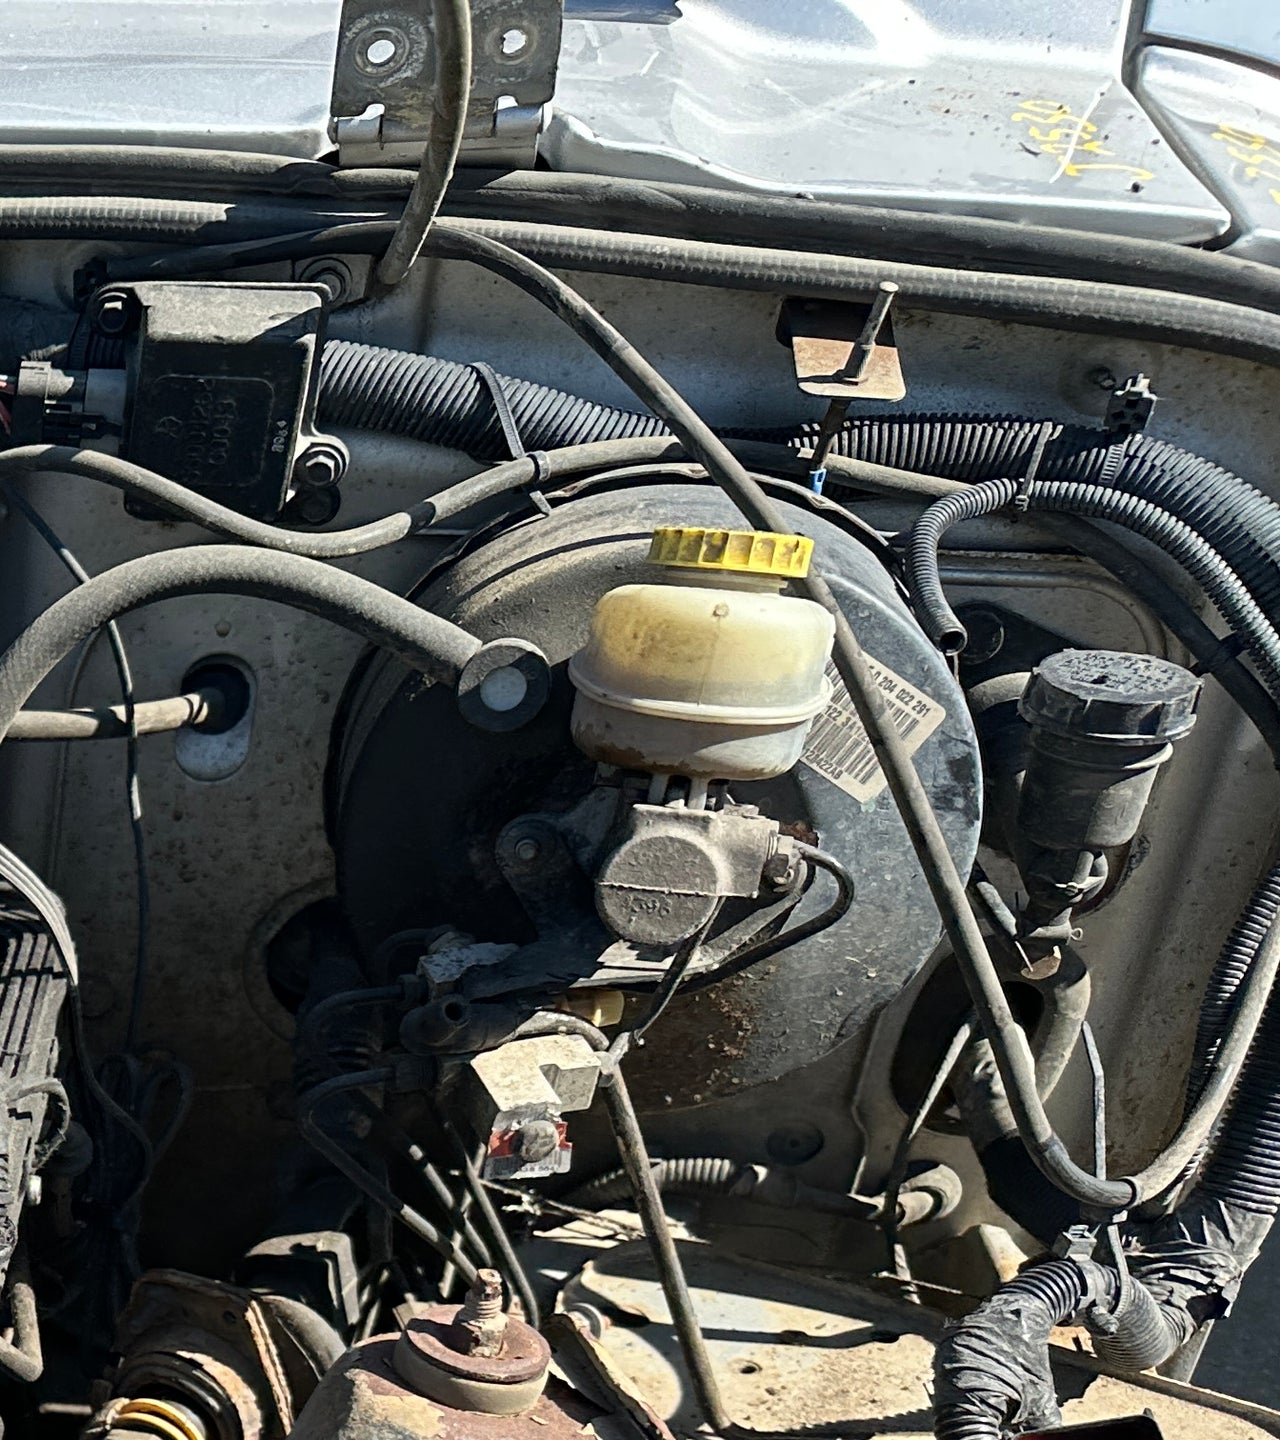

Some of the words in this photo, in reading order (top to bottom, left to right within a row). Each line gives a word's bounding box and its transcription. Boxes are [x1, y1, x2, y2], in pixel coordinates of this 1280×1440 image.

[877, 675, 898, 694] 204
[895, 688, 915, 706] 022
[911, 700, 931, 718] 291
